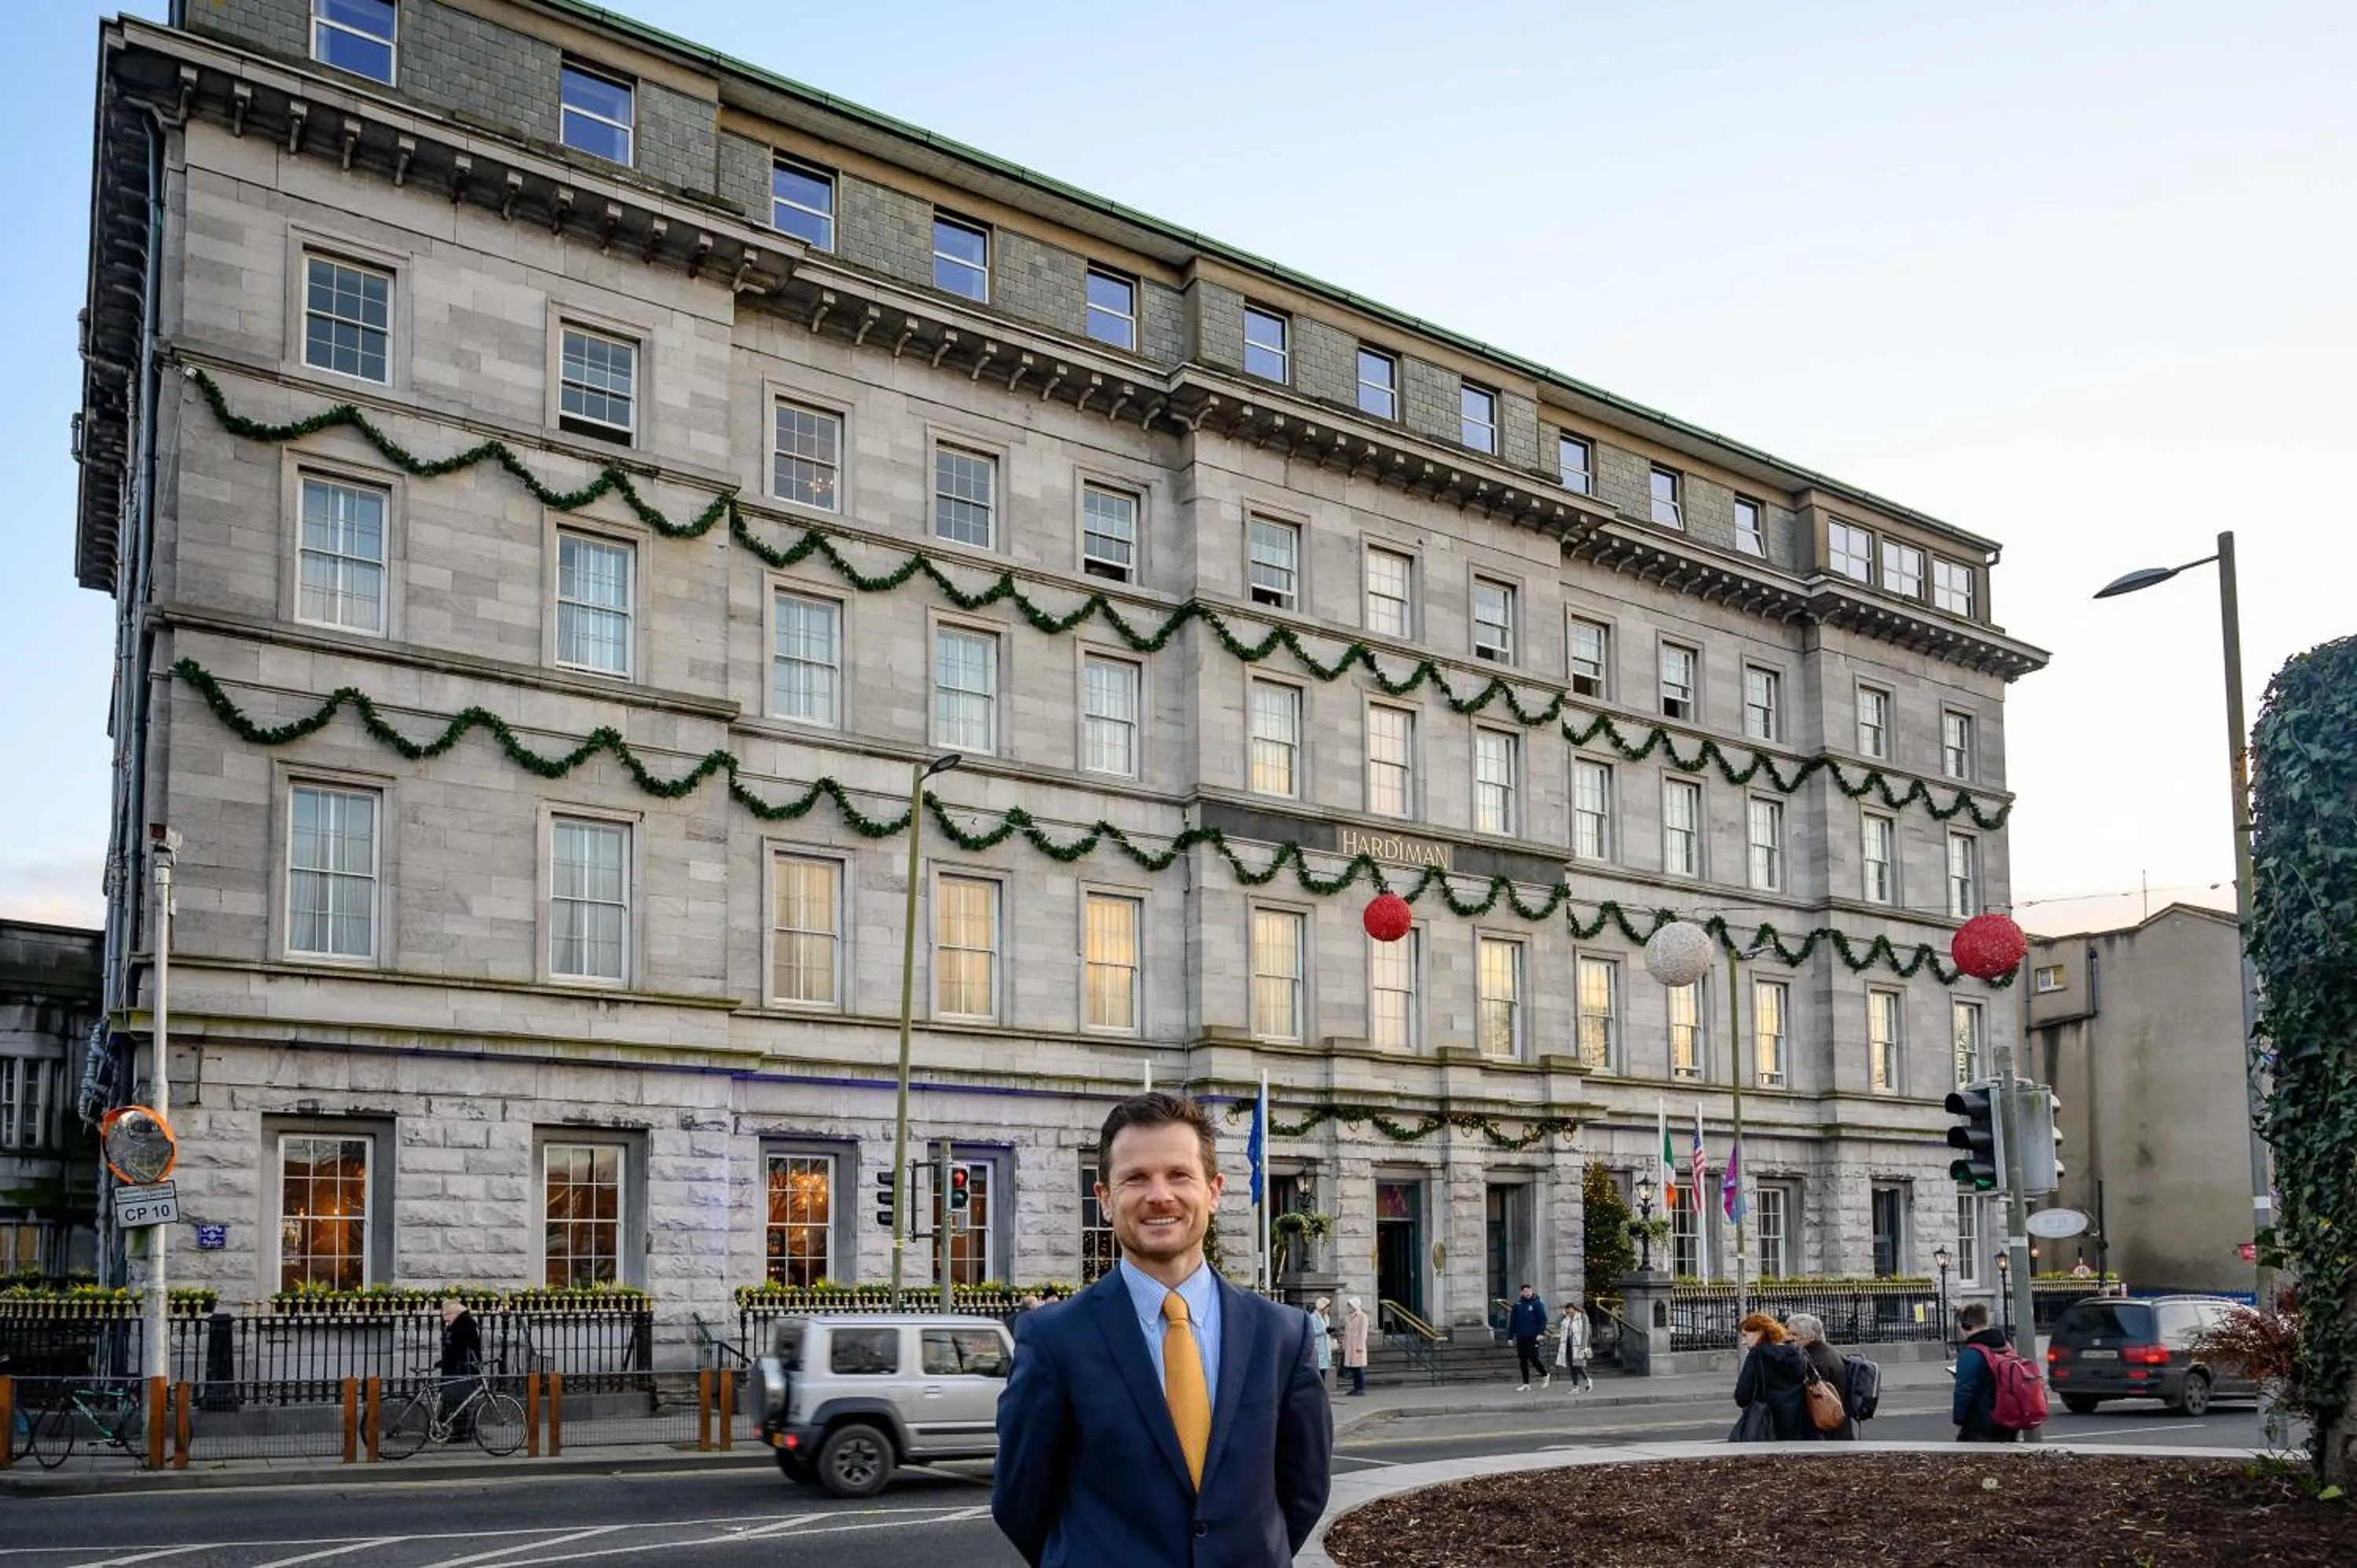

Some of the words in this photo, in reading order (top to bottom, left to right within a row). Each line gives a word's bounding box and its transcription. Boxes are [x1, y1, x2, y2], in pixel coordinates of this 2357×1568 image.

[1342, 830, 1448, 869] HARDIMAN
[125, 1207, 147, 1222] CP
[152, 1204, 170, 1218] 10
